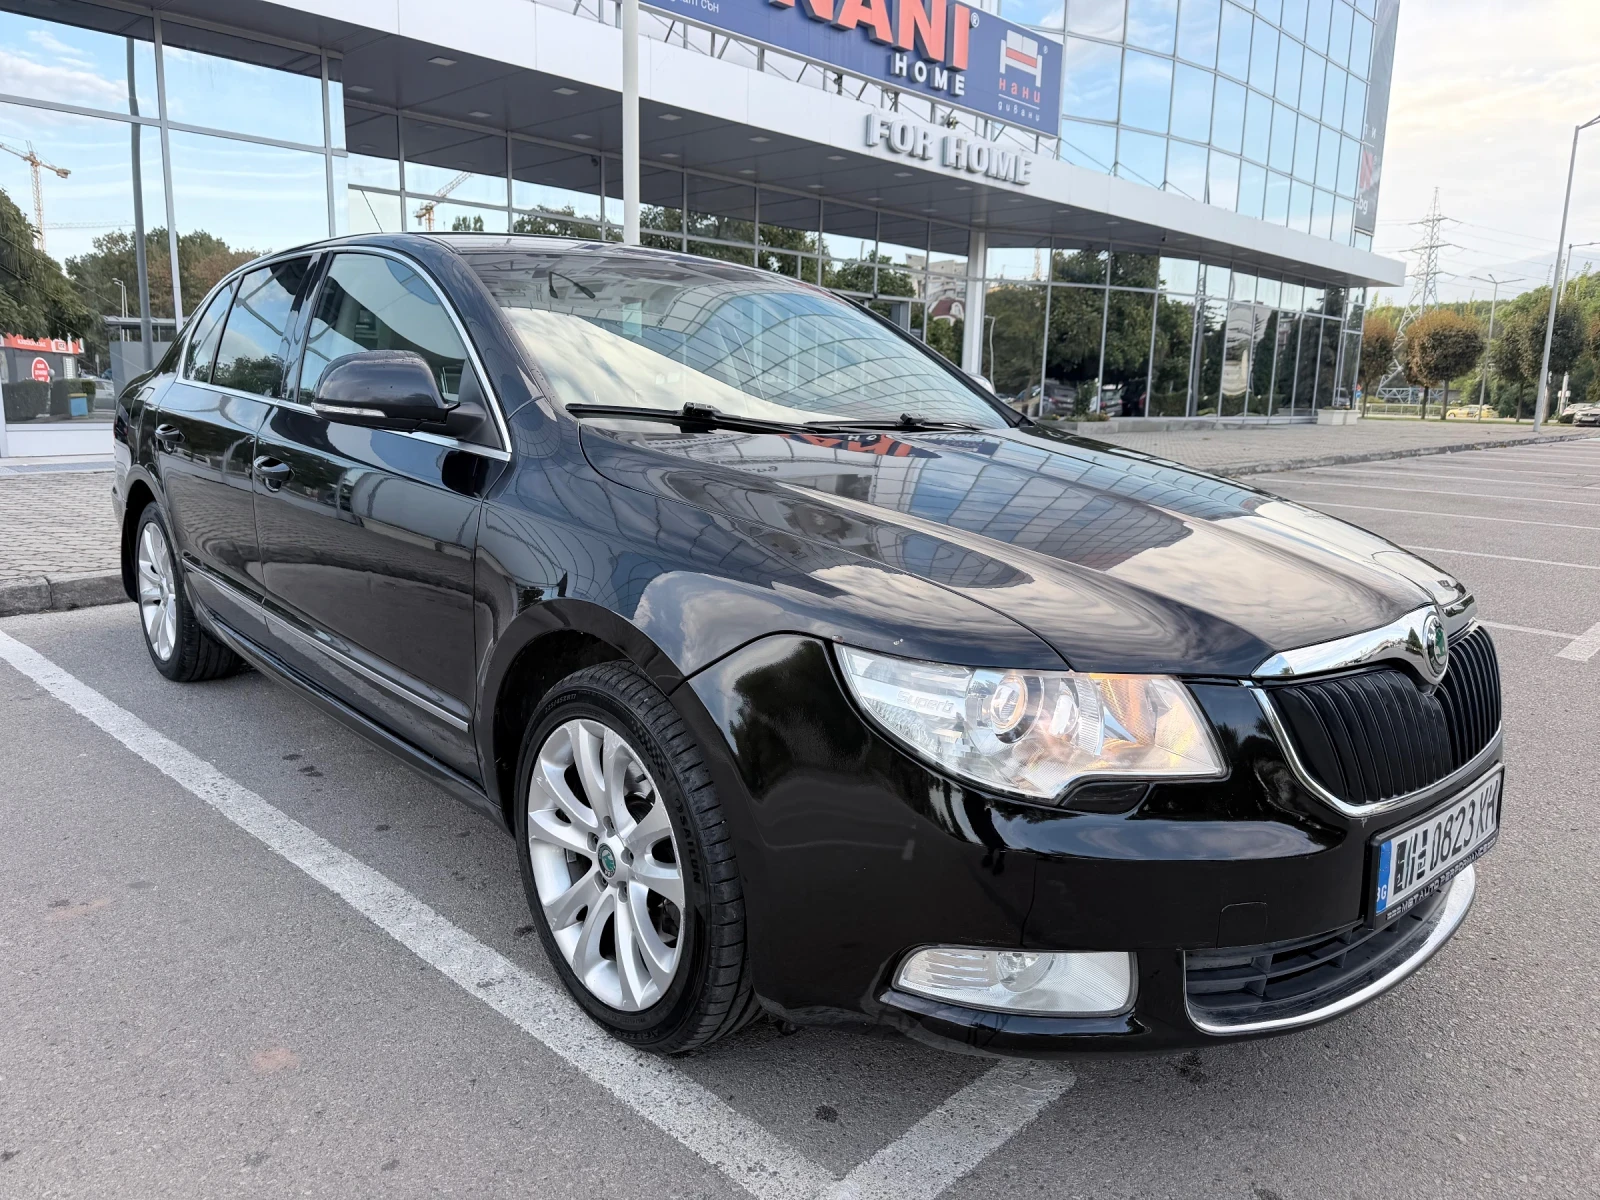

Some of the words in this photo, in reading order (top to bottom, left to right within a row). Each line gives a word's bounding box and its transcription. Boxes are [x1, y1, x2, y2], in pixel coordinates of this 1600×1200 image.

[893, 53, 966, 97] HOME
[867, 113, 933, 160] FOR
[943, 135, 1032, 185] HOME
[897, 690, 954, 713] Superb
[680, 815, 701, 884] SAILUN
[1430, 799, 1476, 872] 0823
[1419, 880, 1440, 901] AUTO
